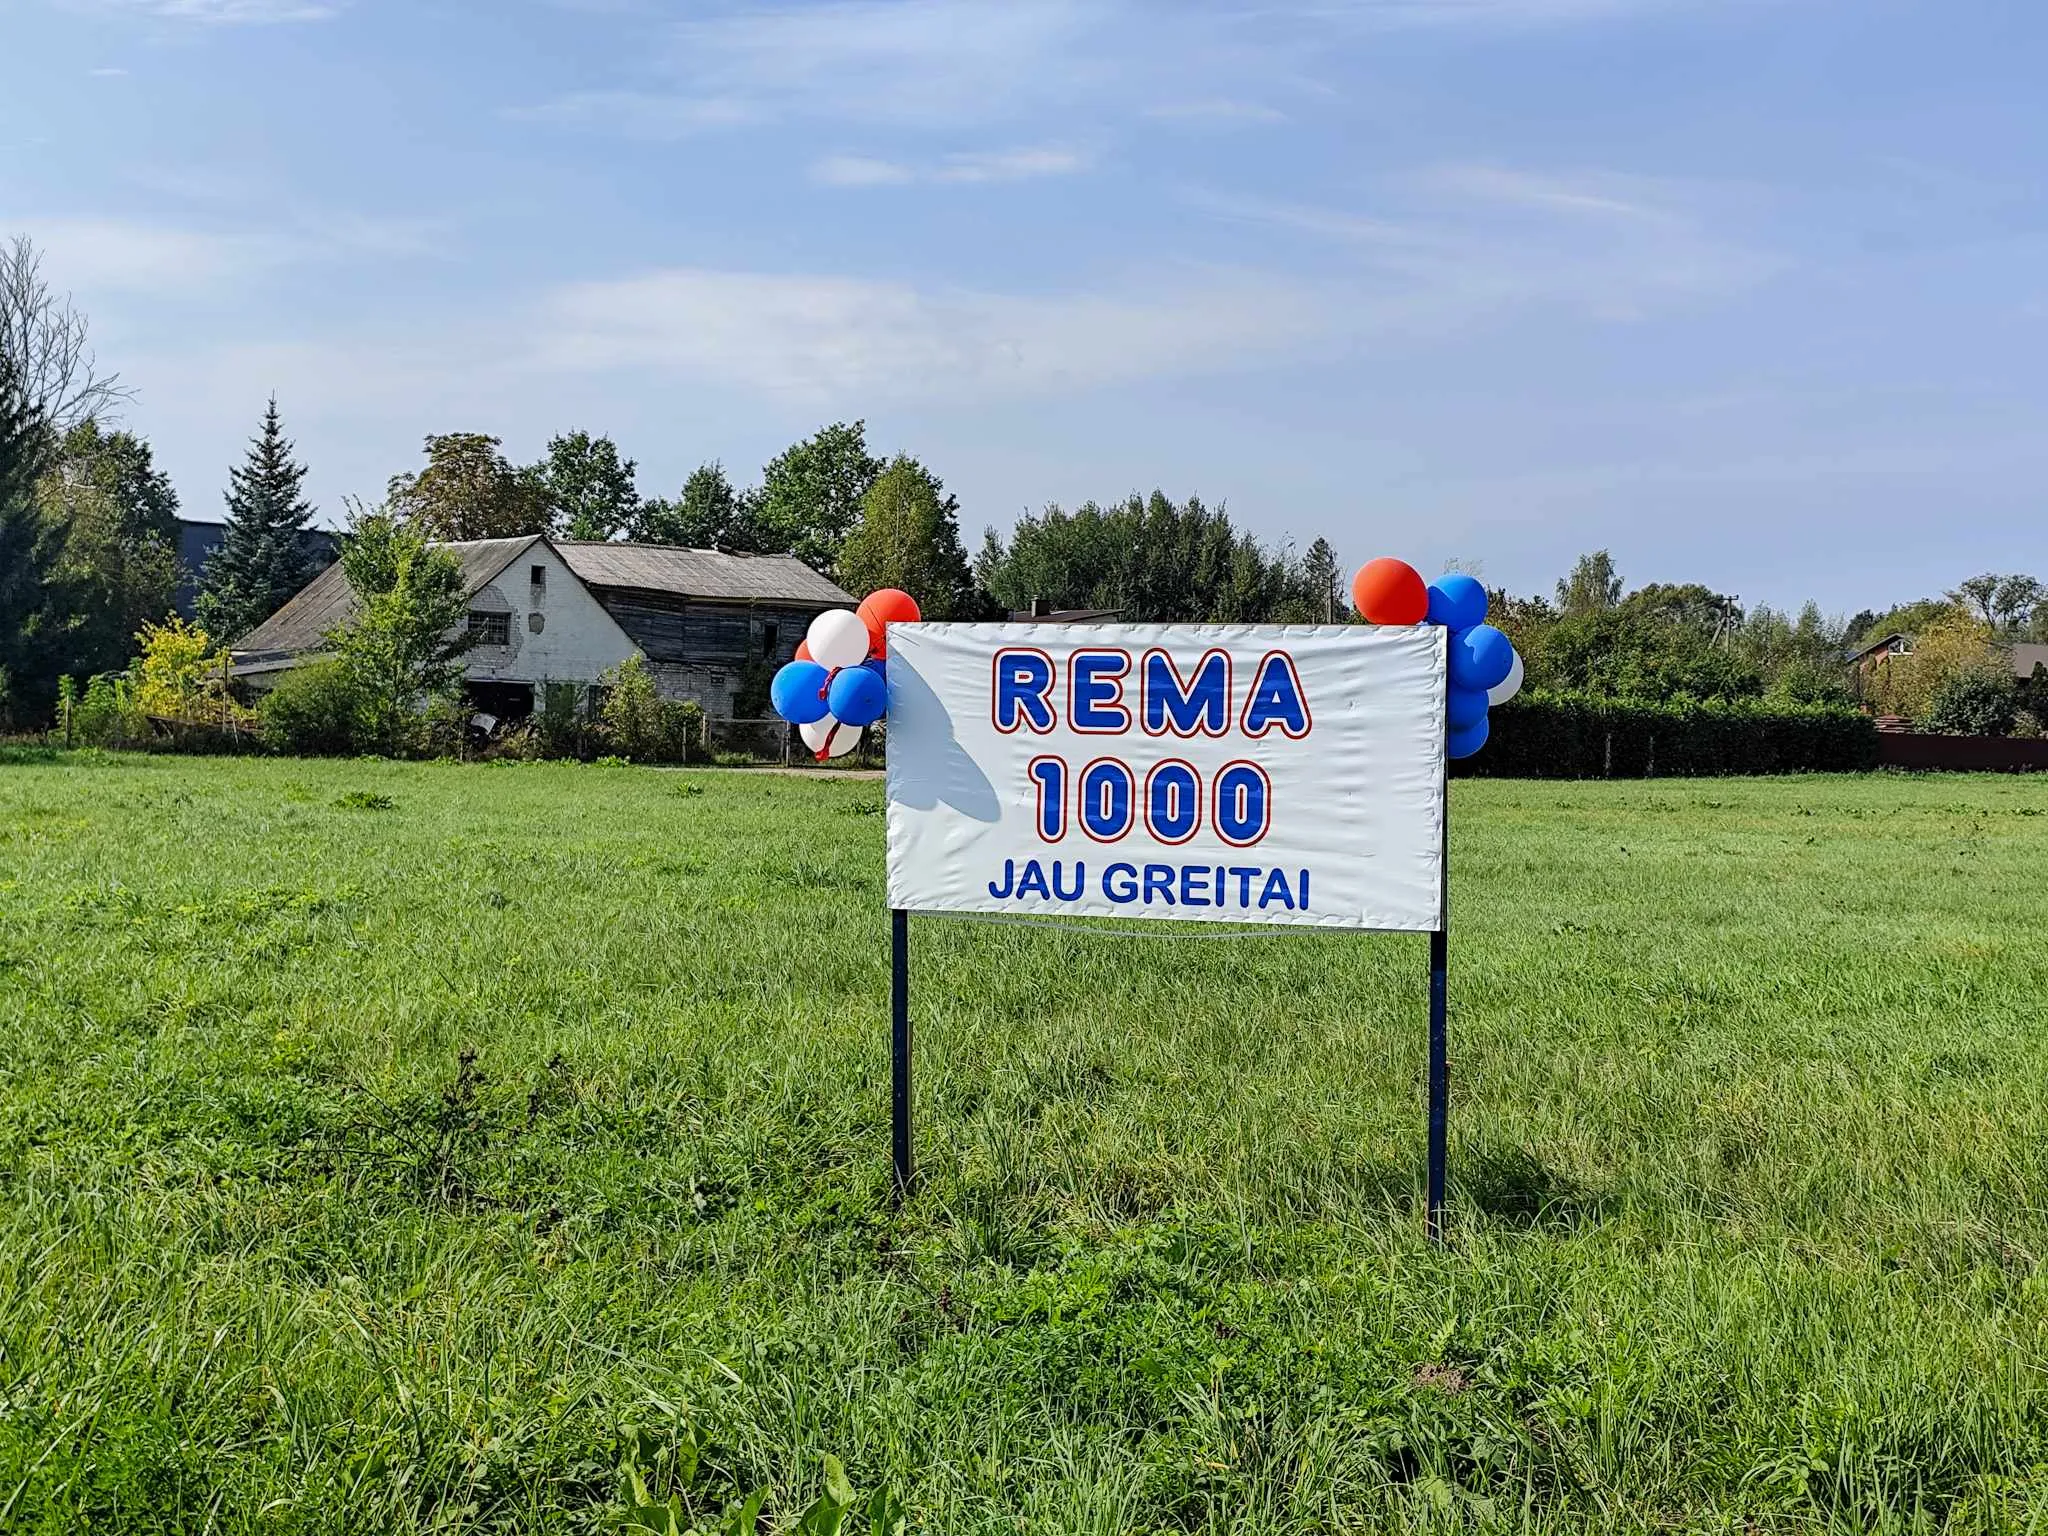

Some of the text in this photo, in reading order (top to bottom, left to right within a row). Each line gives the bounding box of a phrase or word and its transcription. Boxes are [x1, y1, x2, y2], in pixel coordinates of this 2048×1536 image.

[992, 647, 1313, 740] REMA
[1027, 755, 1272, 848] 1000
[988, 858, 1310, 911] JAU GREITAI
